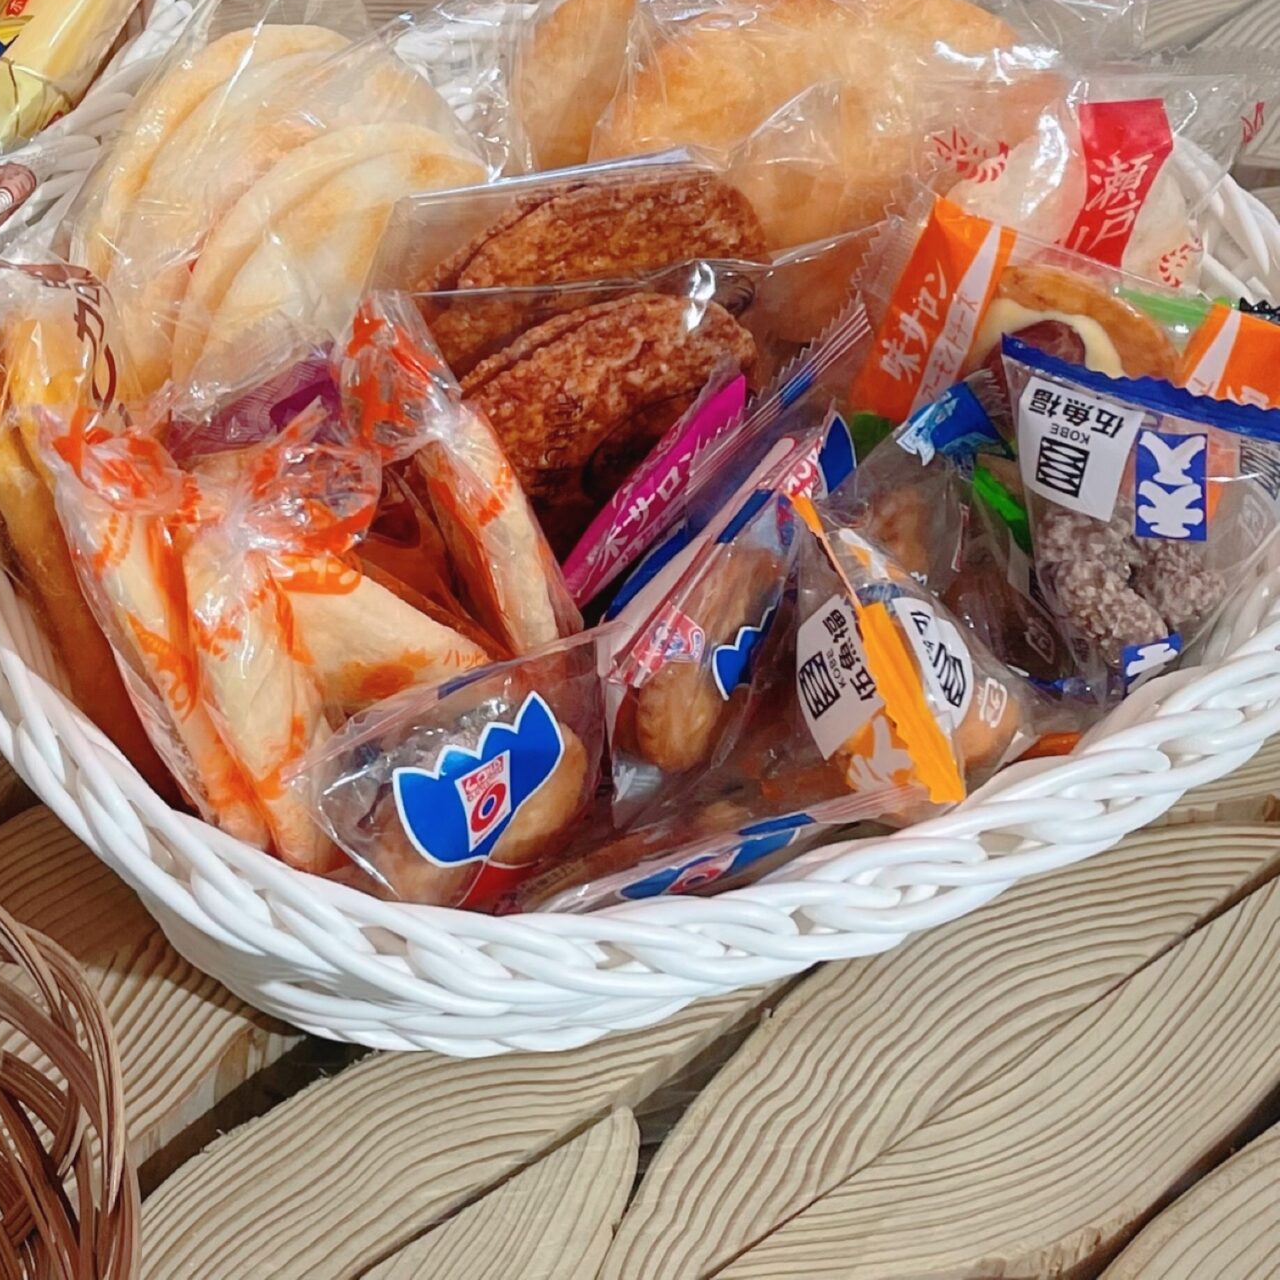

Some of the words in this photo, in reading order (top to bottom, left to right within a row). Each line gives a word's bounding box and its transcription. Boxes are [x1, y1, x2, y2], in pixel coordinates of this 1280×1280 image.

[879, 258, 947, 384] 味サロン
[1028, 387, 1125, 439] 伍魚福
[1049, 423, 1091, 445] KOBE
[822, 608, 878, 702] 伍魚福
[826, 649, 847, 690] KOBE
